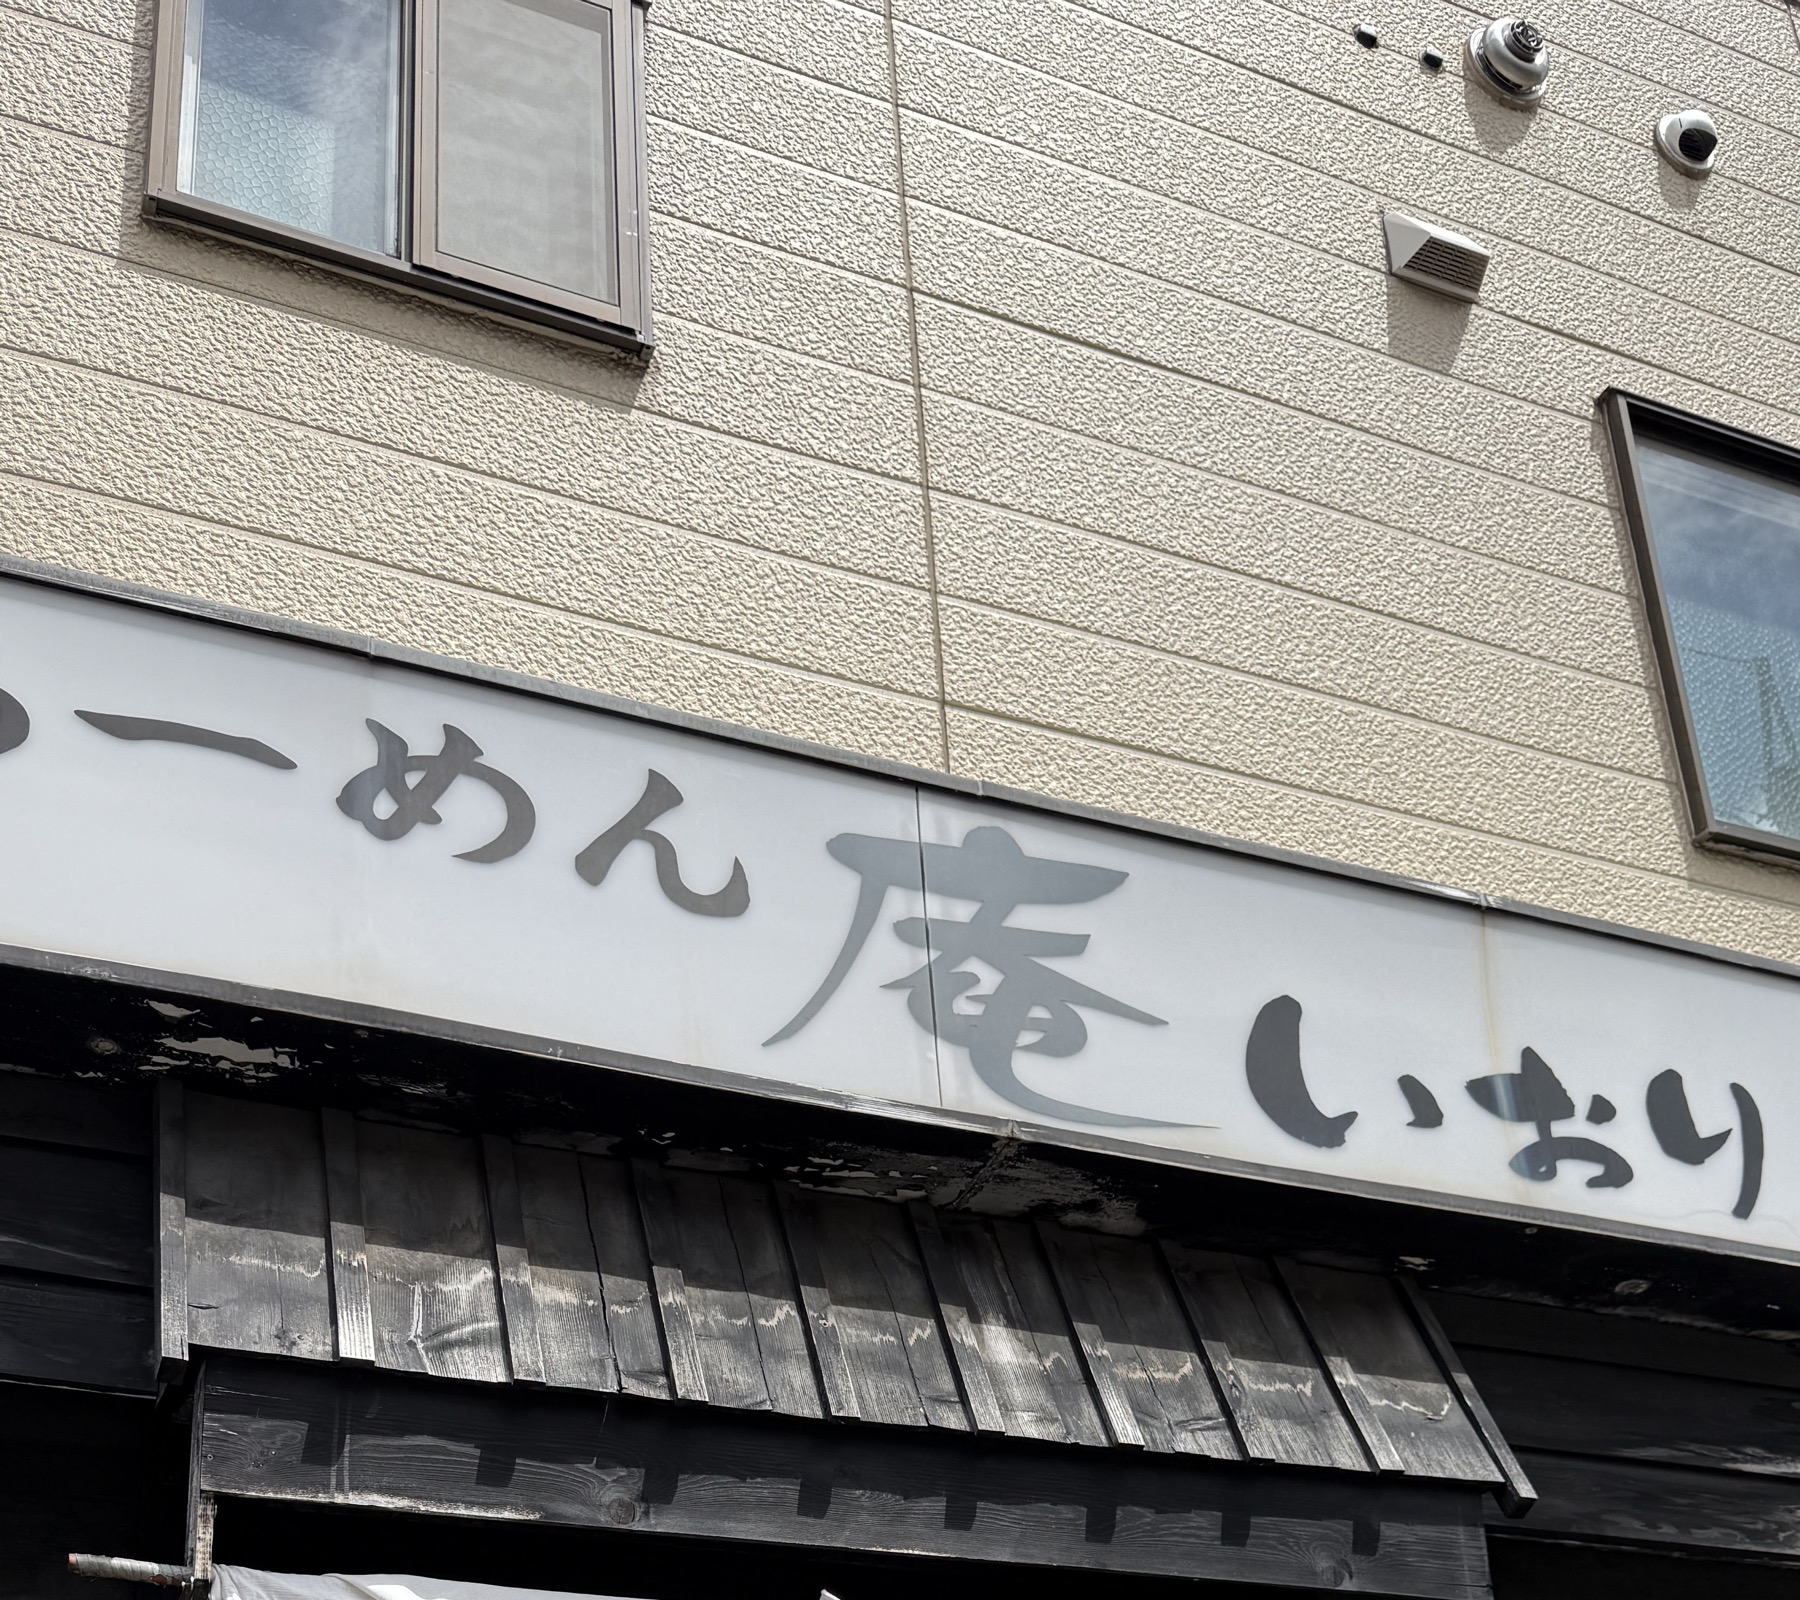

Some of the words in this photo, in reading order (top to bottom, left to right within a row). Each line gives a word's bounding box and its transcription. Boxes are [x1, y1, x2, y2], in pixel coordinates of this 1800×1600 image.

[0, 687, 751, 919] ーめん
[762, 825, 1222, 1130] 庵
[1244, 994, 1764, 1221] いおり
